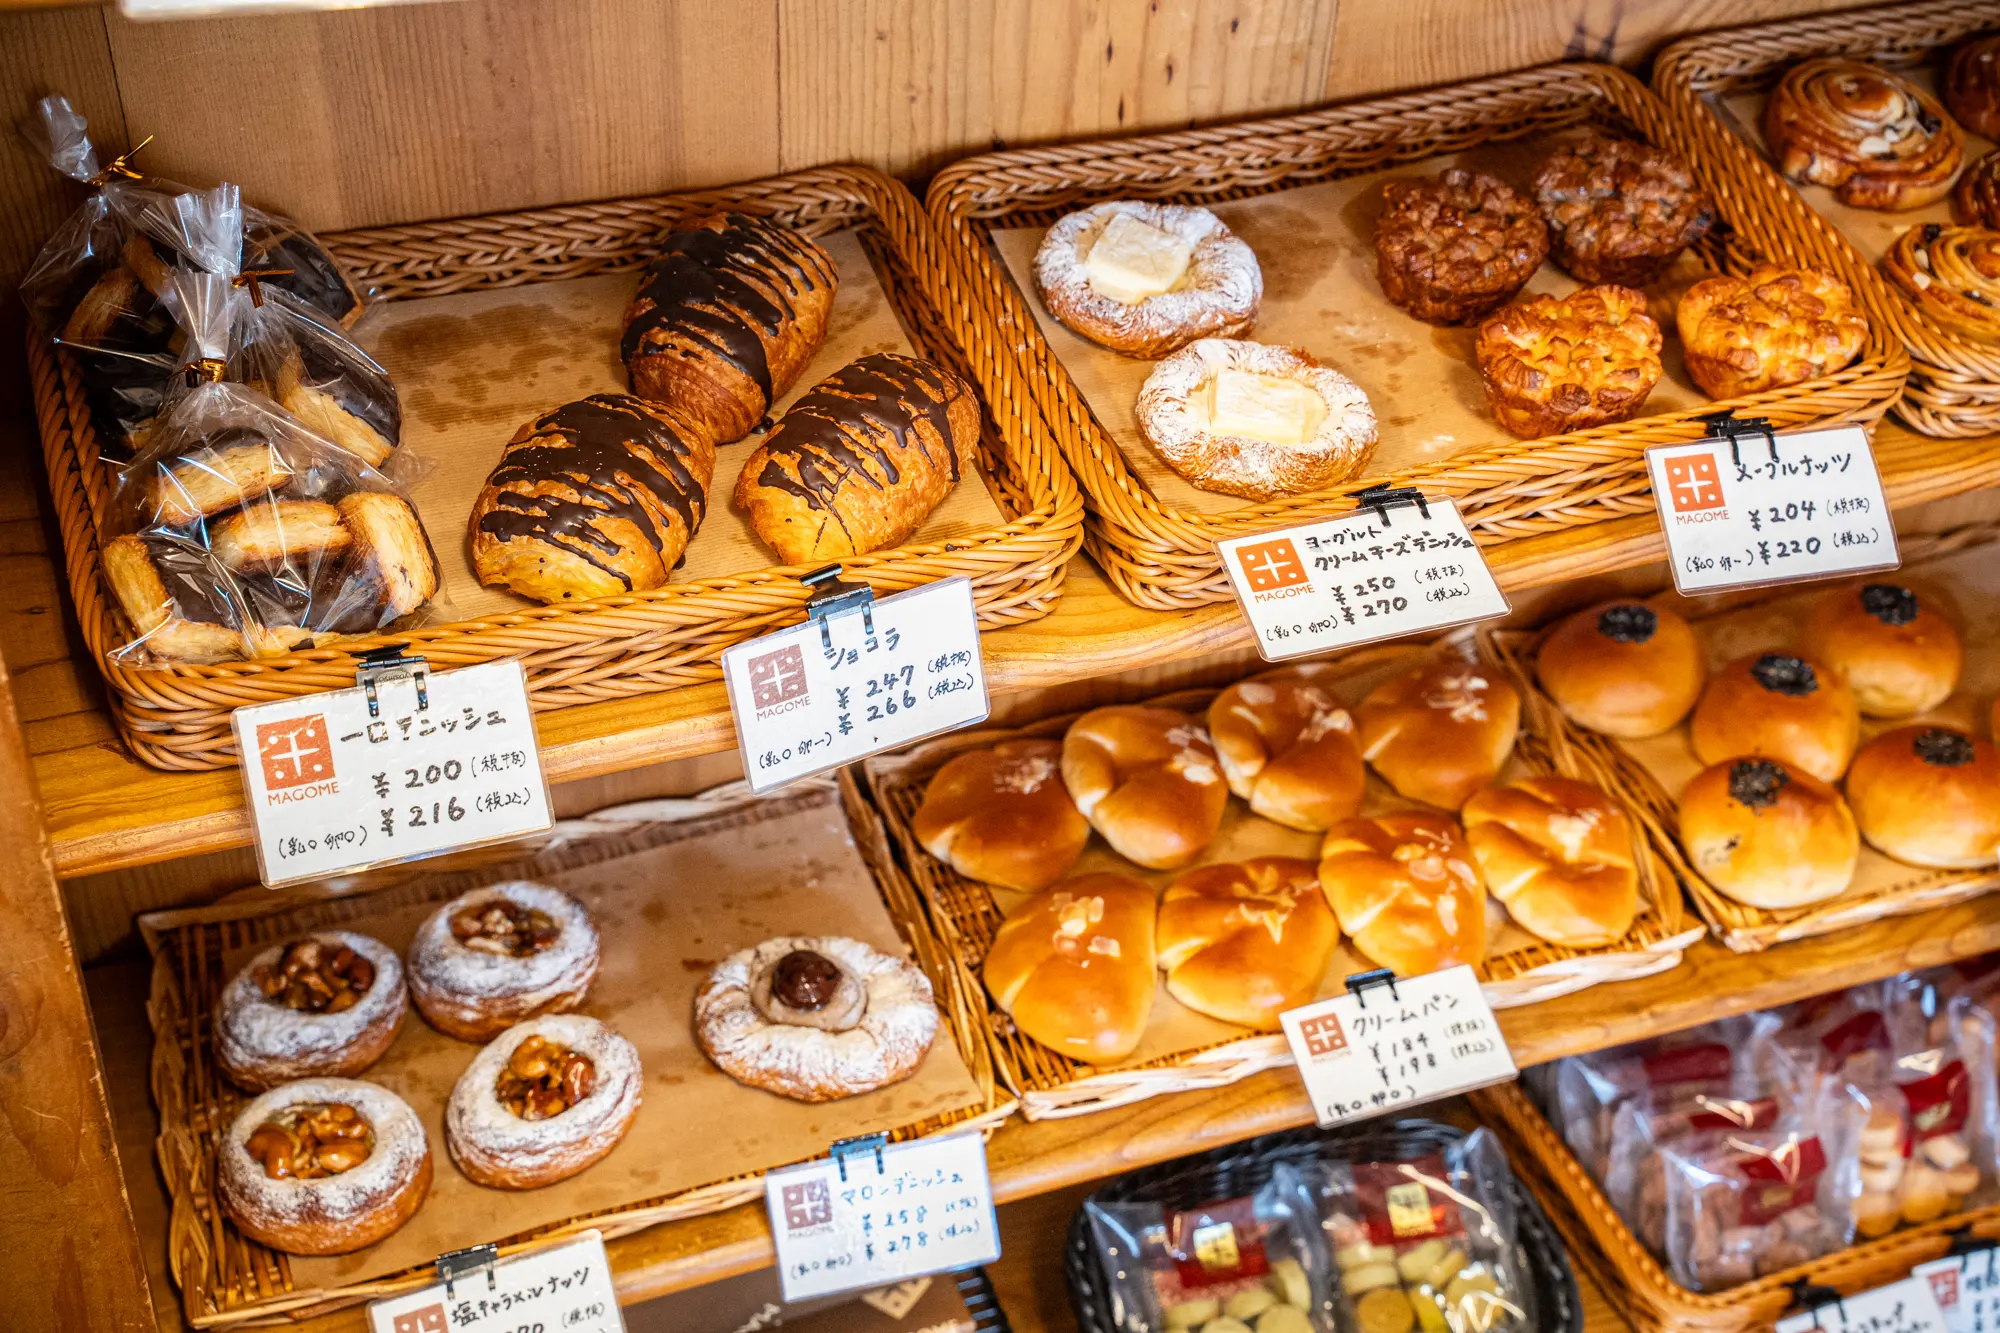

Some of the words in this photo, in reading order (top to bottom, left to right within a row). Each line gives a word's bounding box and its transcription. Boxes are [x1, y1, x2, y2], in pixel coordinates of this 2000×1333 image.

[1735, 453, 1851, 483] メープルナッツ
[1676, 509, 1730, 526] MAGOME
[1305, 525, 1382, 550] ヨーグルト
[1254, 584, 1316, 604] MAGOME
[824, 627, 900, 670] ショコラ
[756, 696, 812, 721] MAGOME
[267, 781, 340, 806] MAGOME
[1353, 994, 1458, 1037] クリームパン
[451, 1266, 590, 1328] 塩キャラメルナッツ
